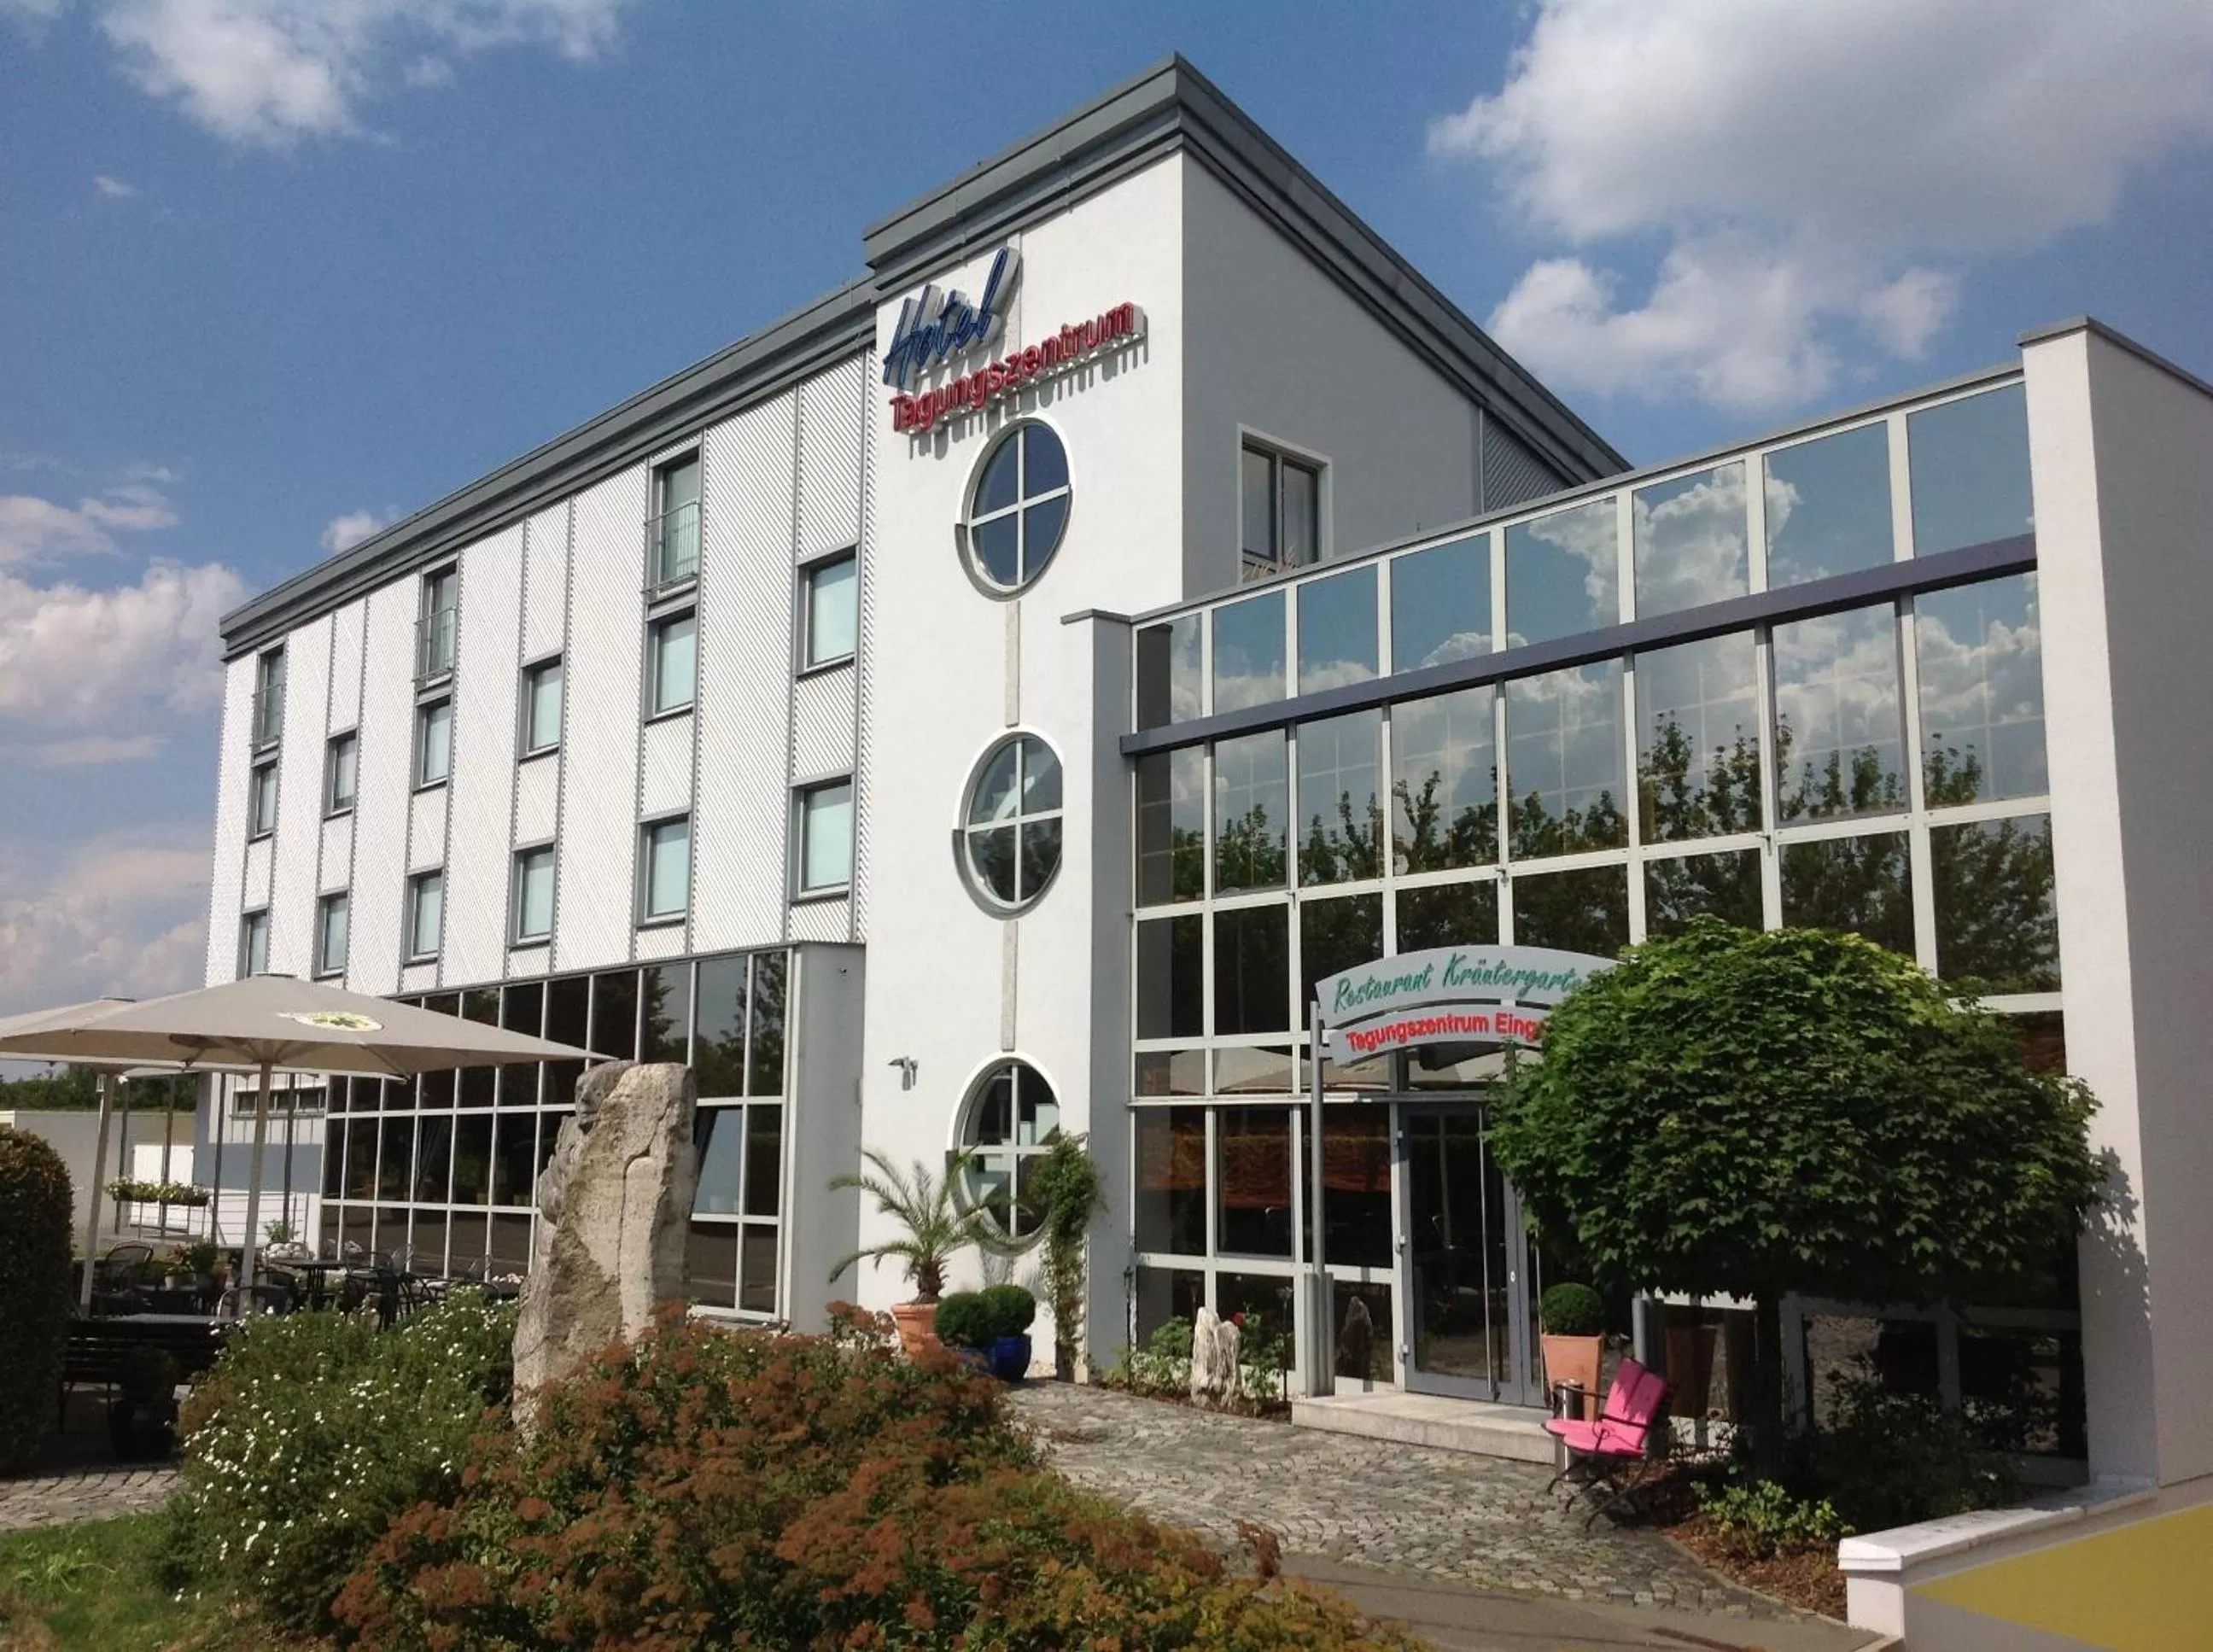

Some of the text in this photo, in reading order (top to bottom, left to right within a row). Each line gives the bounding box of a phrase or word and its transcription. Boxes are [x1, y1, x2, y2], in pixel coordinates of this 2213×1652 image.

[883, 245, 1009, 390] Hotel
[890, 302, 1135, 432] Tagungszentrum
[1334, 963, 1433, 1014] Restaurant
[1346, 1013, 1489, 1052] Tagungszentrum
